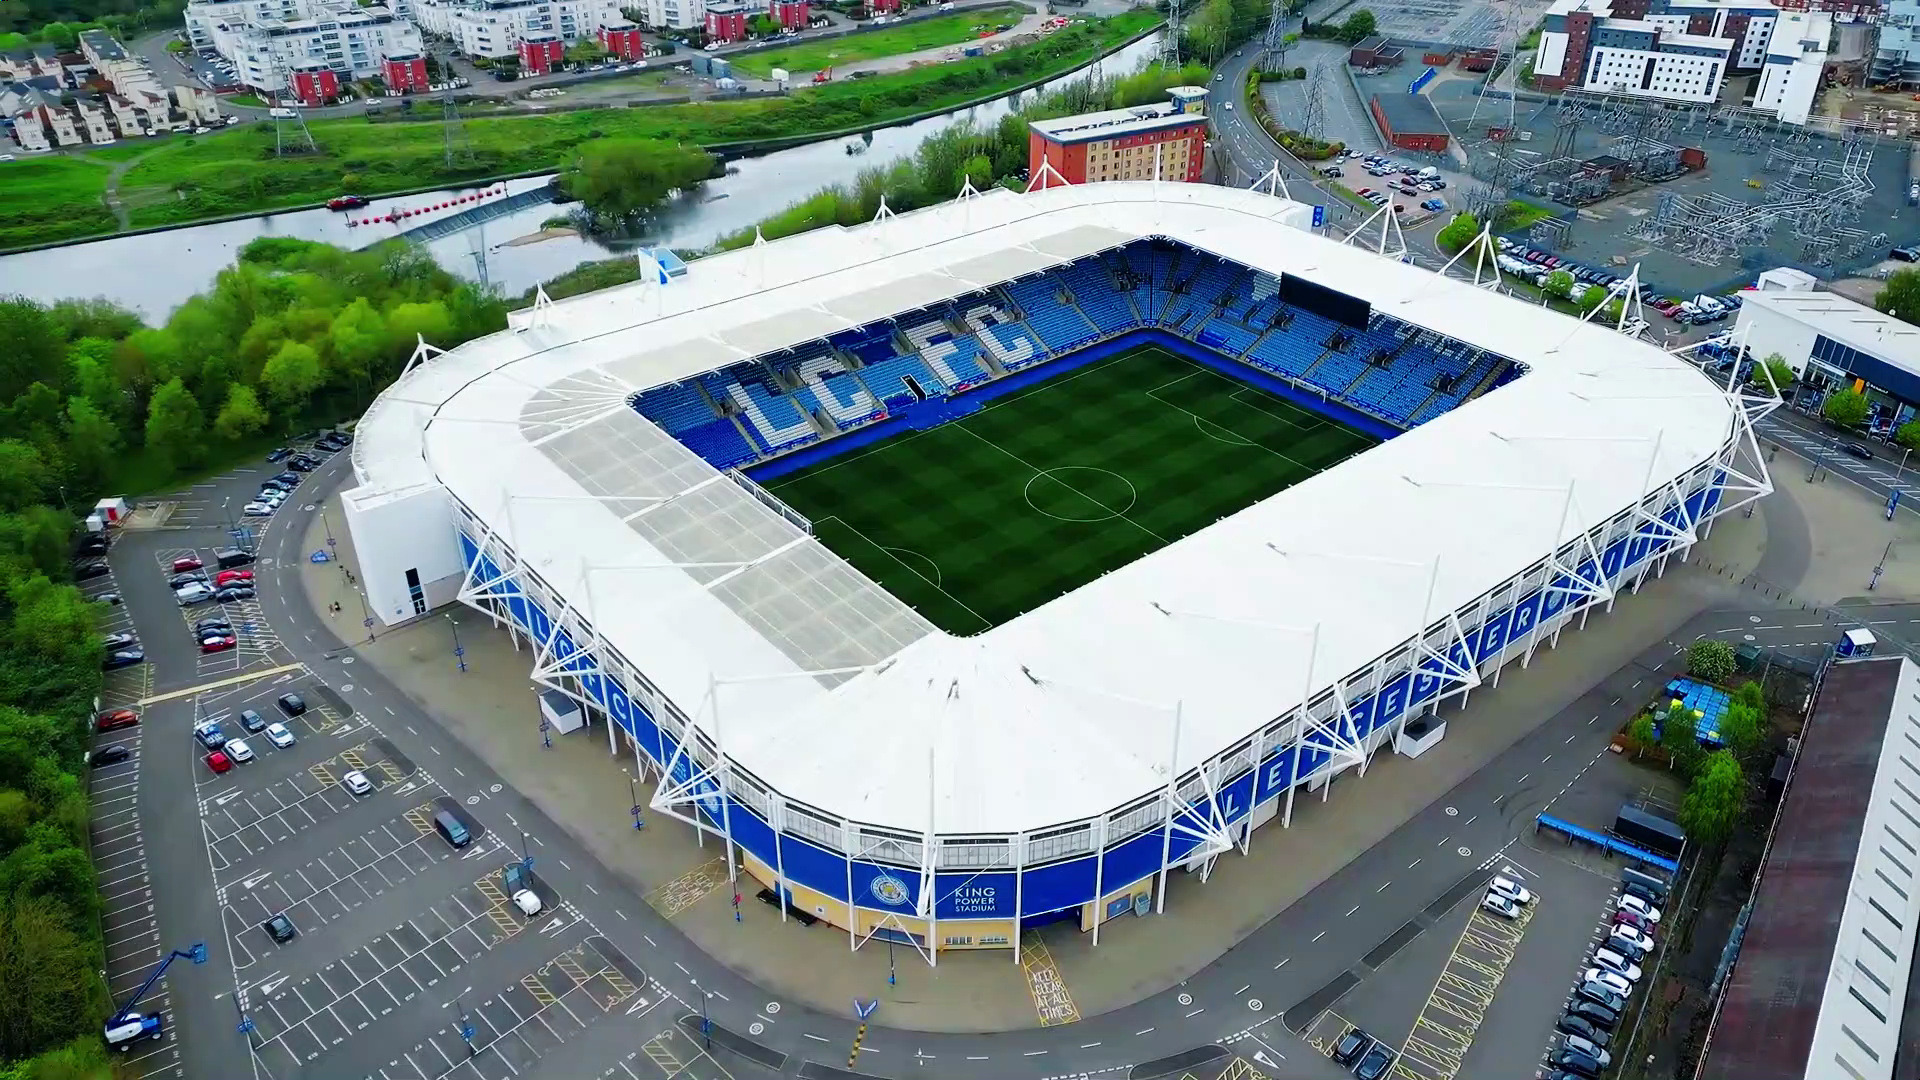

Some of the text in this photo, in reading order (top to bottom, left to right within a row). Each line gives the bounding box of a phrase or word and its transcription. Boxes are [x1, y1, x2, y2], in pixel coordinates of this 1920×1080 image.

[1226, 606, 1532, 818] LEICESTER
[955, 887, 996, 898] KING
[955, 897, 995, 905] POWER
[1033, 969, 1055, 984] KEEP
[1035, 981, 1064, 996] CLEAR
[1036, 992, 1070, 1008] AT ALL
[1042, 1004, 1073, 1020] TIMES
